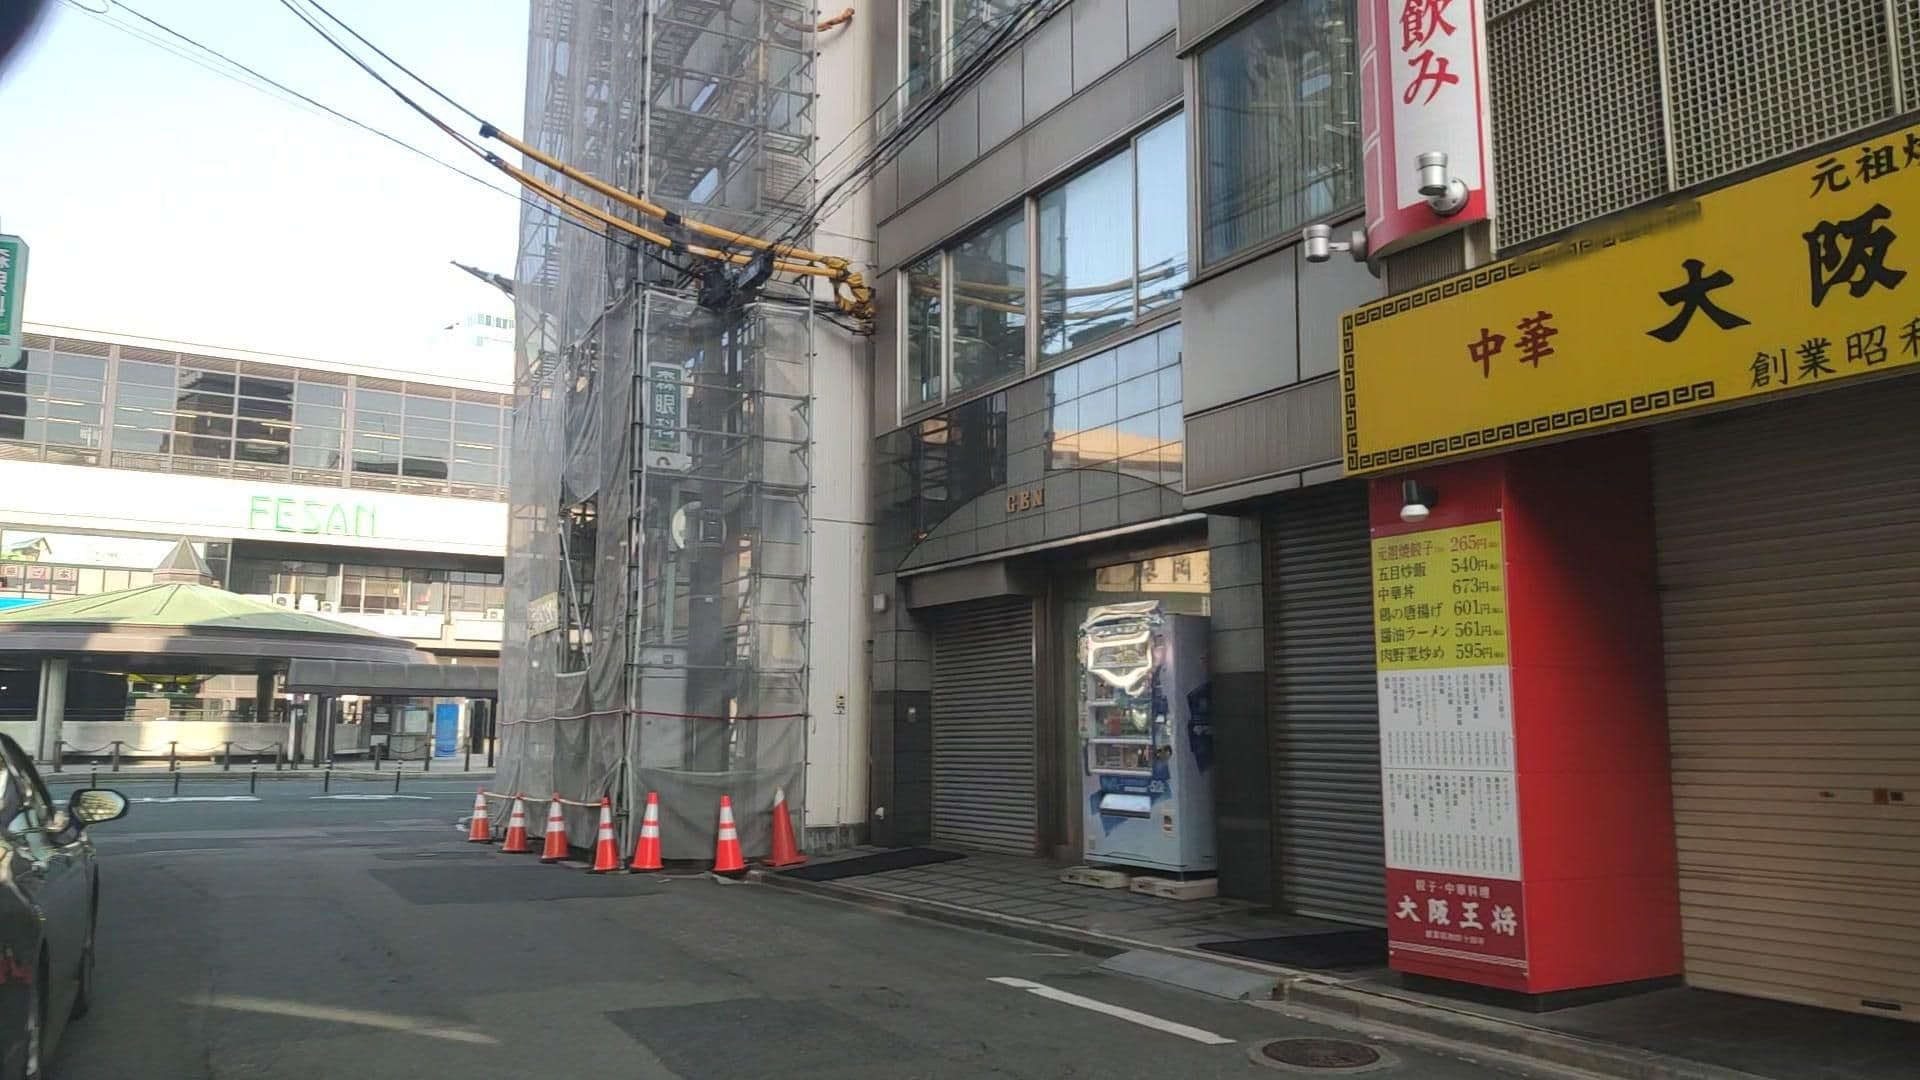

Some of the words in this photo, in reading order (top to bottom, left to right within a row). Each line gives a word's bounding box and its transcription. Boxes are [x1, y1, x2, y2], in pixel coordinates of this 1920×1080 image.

[1467, 310, 1558, 379] 中華
[247, 495, 377, 538] FESAN
[1395, 895, 1518, 937] 大阪王将
